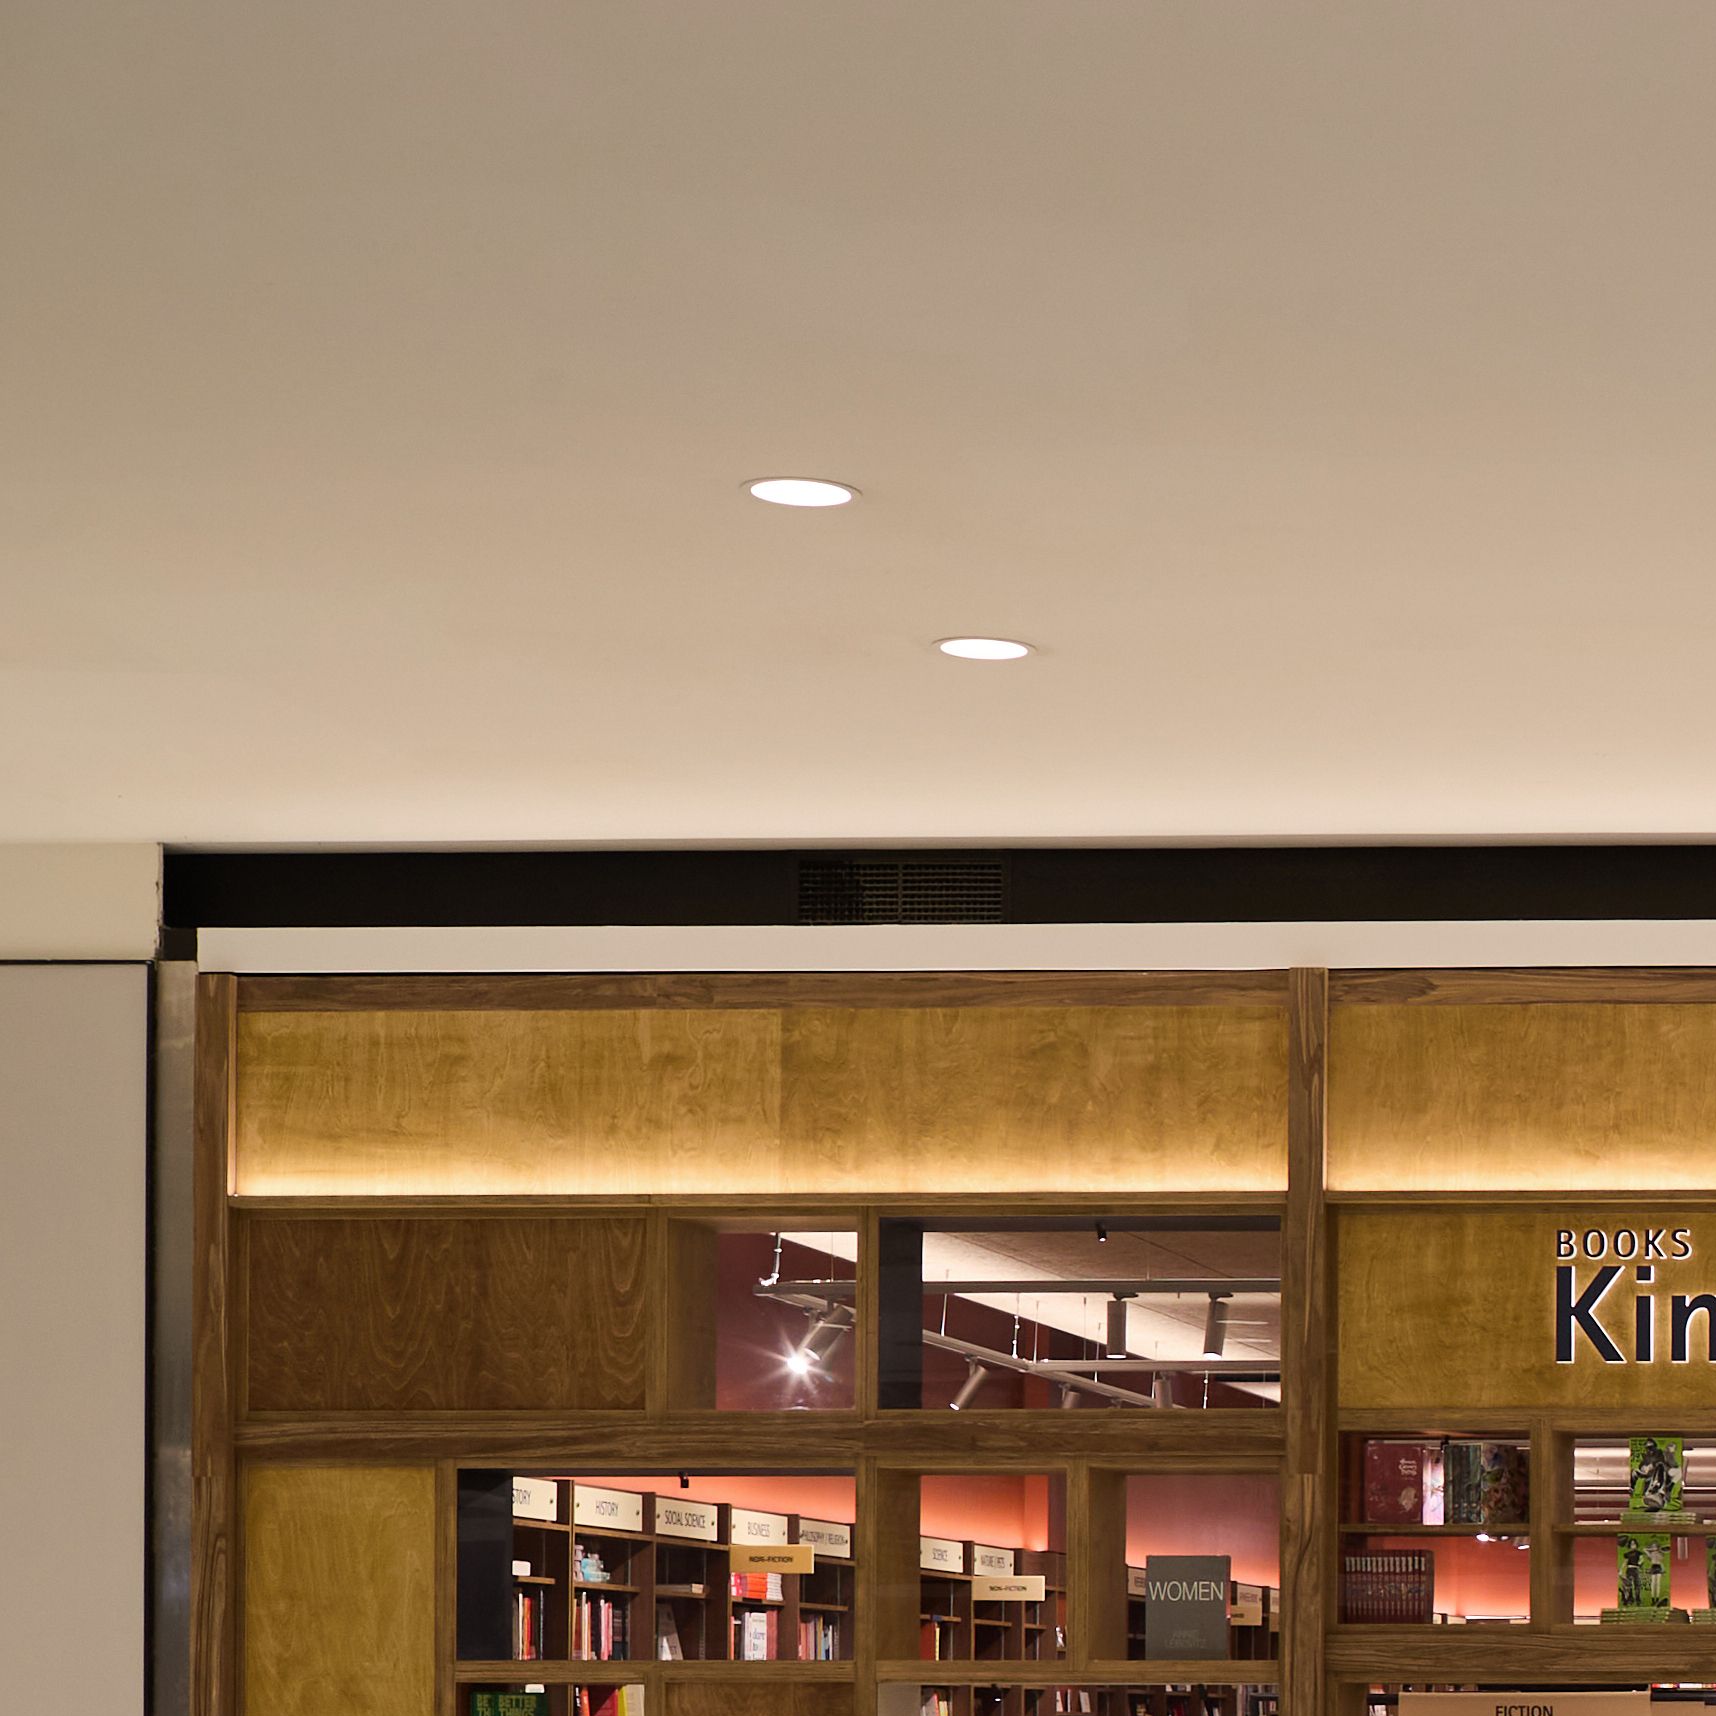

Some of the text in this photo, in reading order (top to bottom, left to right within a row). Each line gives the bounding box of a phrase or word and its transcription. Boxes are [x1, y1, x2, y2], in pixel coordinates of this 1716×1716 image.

[1556, 1228, 1692, 1259] BOOKS
[595, 1501, 618, 1517] HISTORY
[665, 1510, 706, 1528] SOCIAL SCIENCE
[1148, 1581, 1224, 1601] WOMEN
[498, 1695, 537, 1708] BETTER
